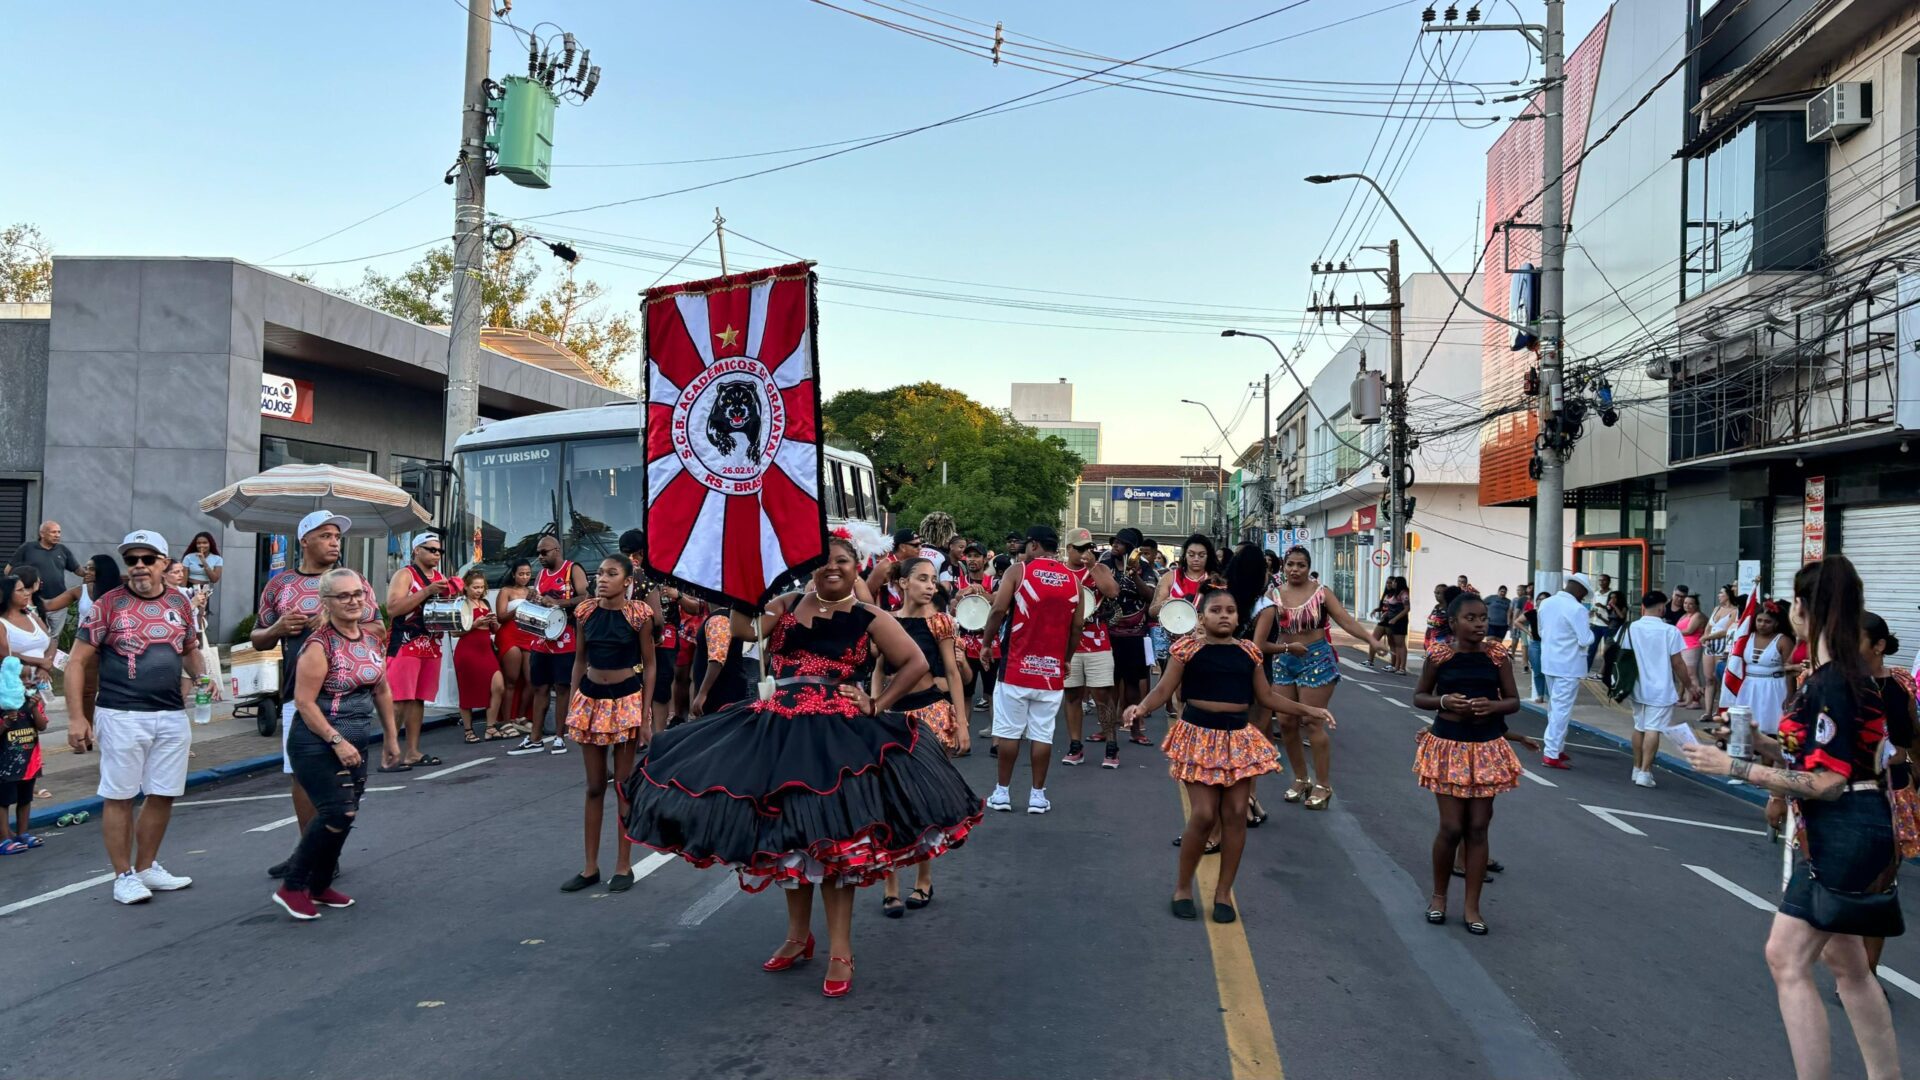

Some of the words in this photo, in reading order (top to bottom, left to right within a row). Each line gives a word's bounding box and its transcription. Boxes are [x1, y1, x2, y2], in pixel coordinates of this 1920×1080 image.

[679, 359, 757, 411] ACADÊMICOS
[482, 455, 496, 465] JV
[498, 448, 550, 463] TURISMO
[704, 473, 723, 489] RS
